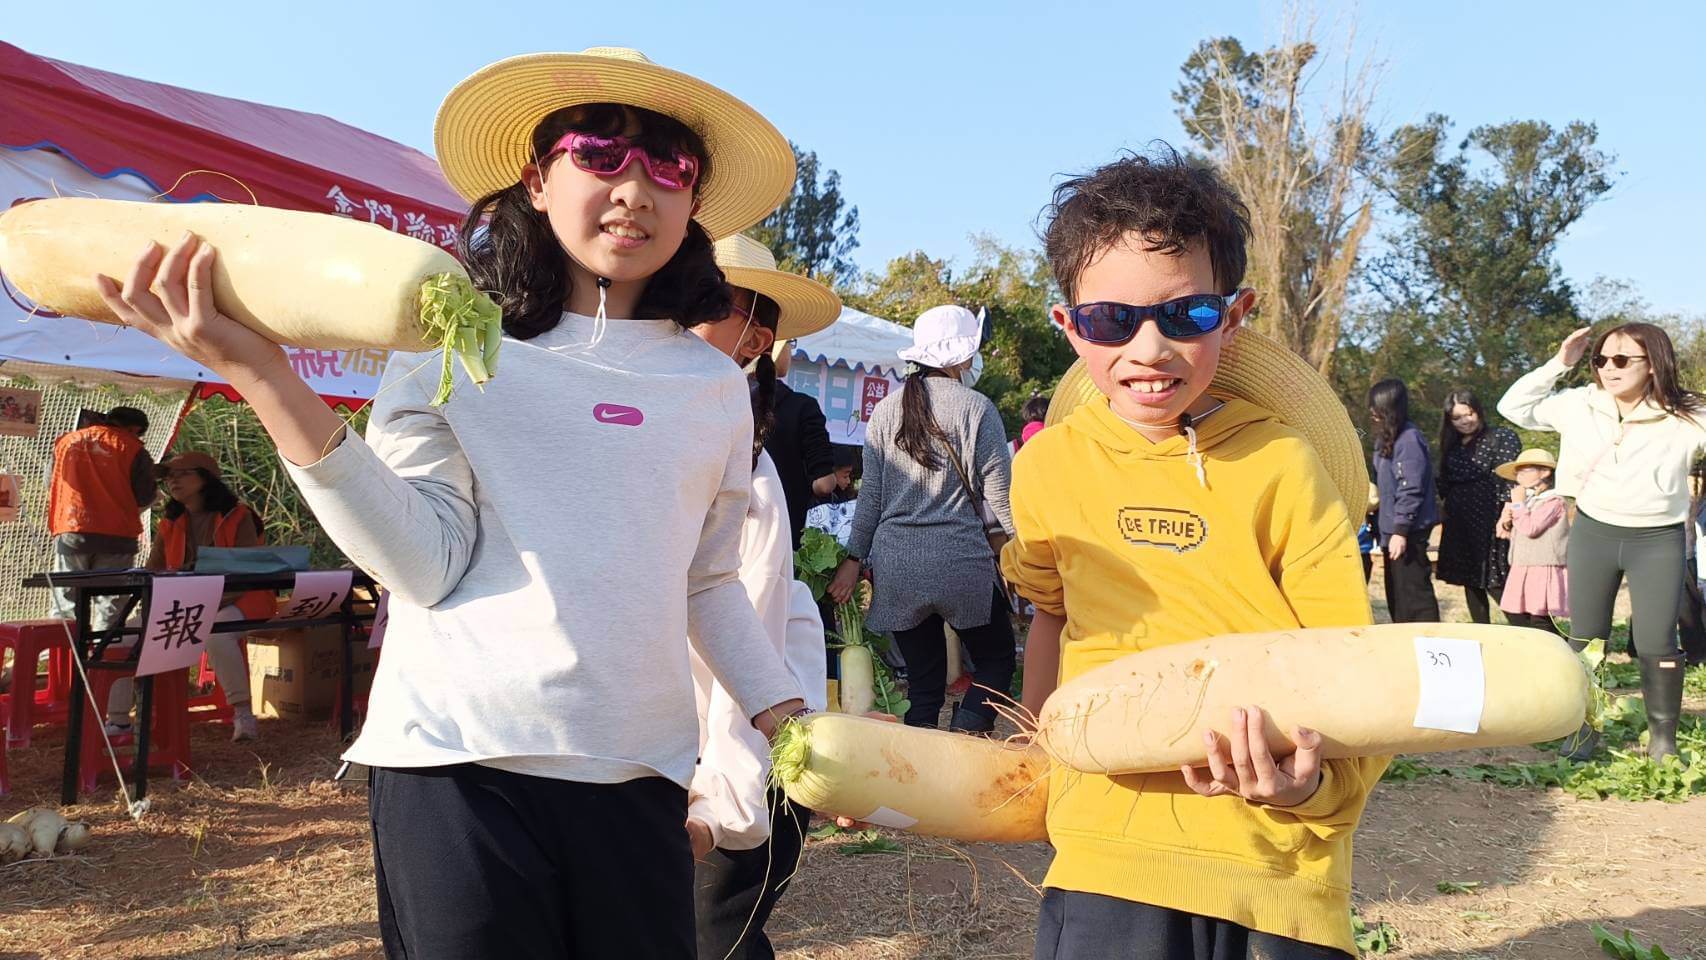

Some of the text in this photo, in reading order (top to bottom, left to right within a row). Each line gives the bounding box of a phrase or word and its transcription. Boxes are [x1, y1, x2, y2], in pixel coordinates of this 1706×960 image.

[866, 382, 886, 398] 公益
[1124, 517, 1195, 538] BE TRUE
[279, 591, 338, 619] 到
[152, 599, 206, 650] 報
